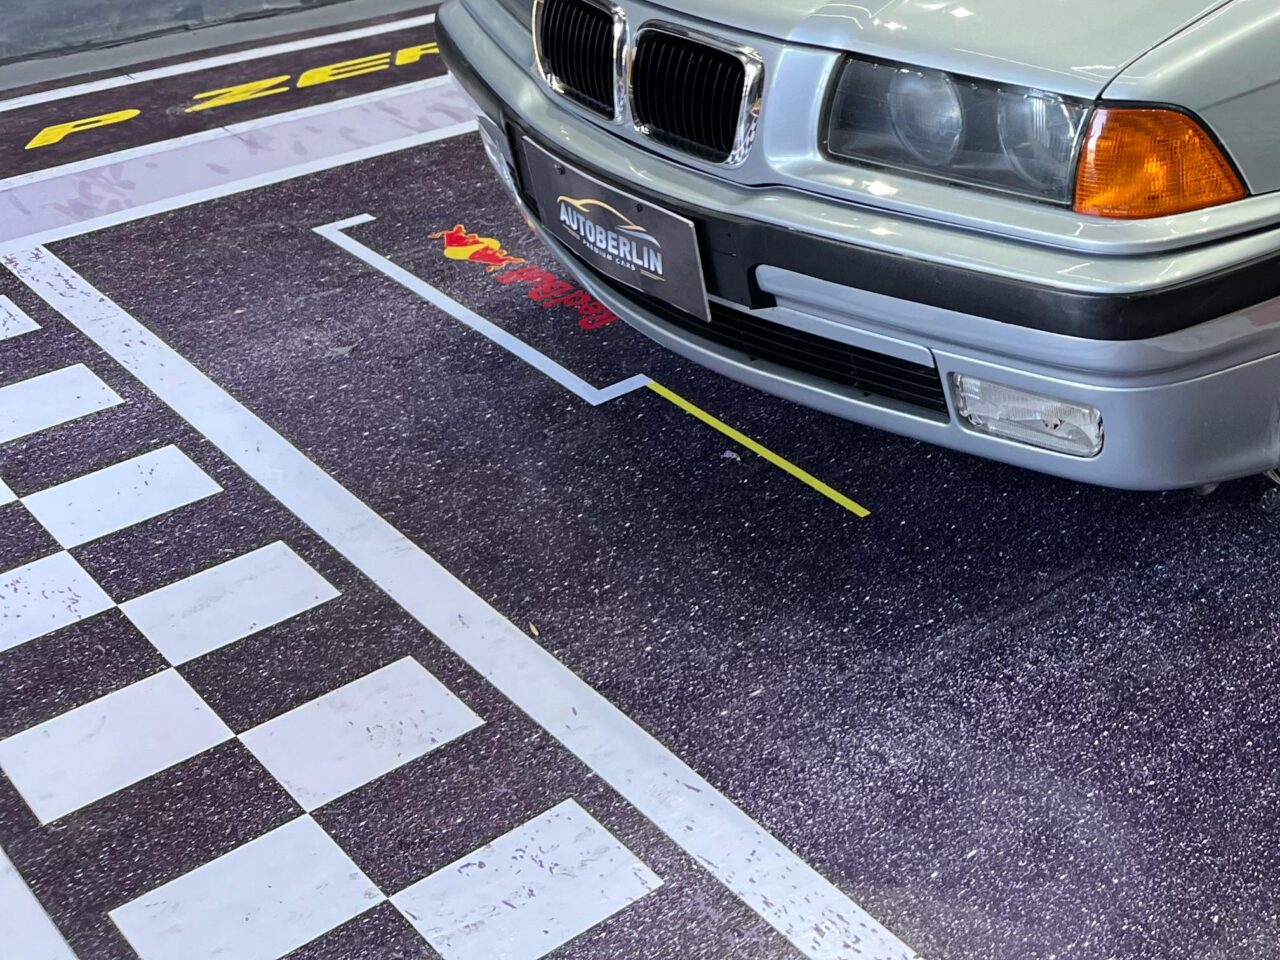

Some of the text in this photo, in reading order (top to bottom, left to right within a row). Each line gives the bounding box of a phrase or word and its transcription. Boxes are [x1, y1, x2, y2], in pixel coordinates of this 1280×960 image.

[559, 201, 663, 275] AUTOBERLIN
[582, 238, 636, 271] PREMIUM CARS
